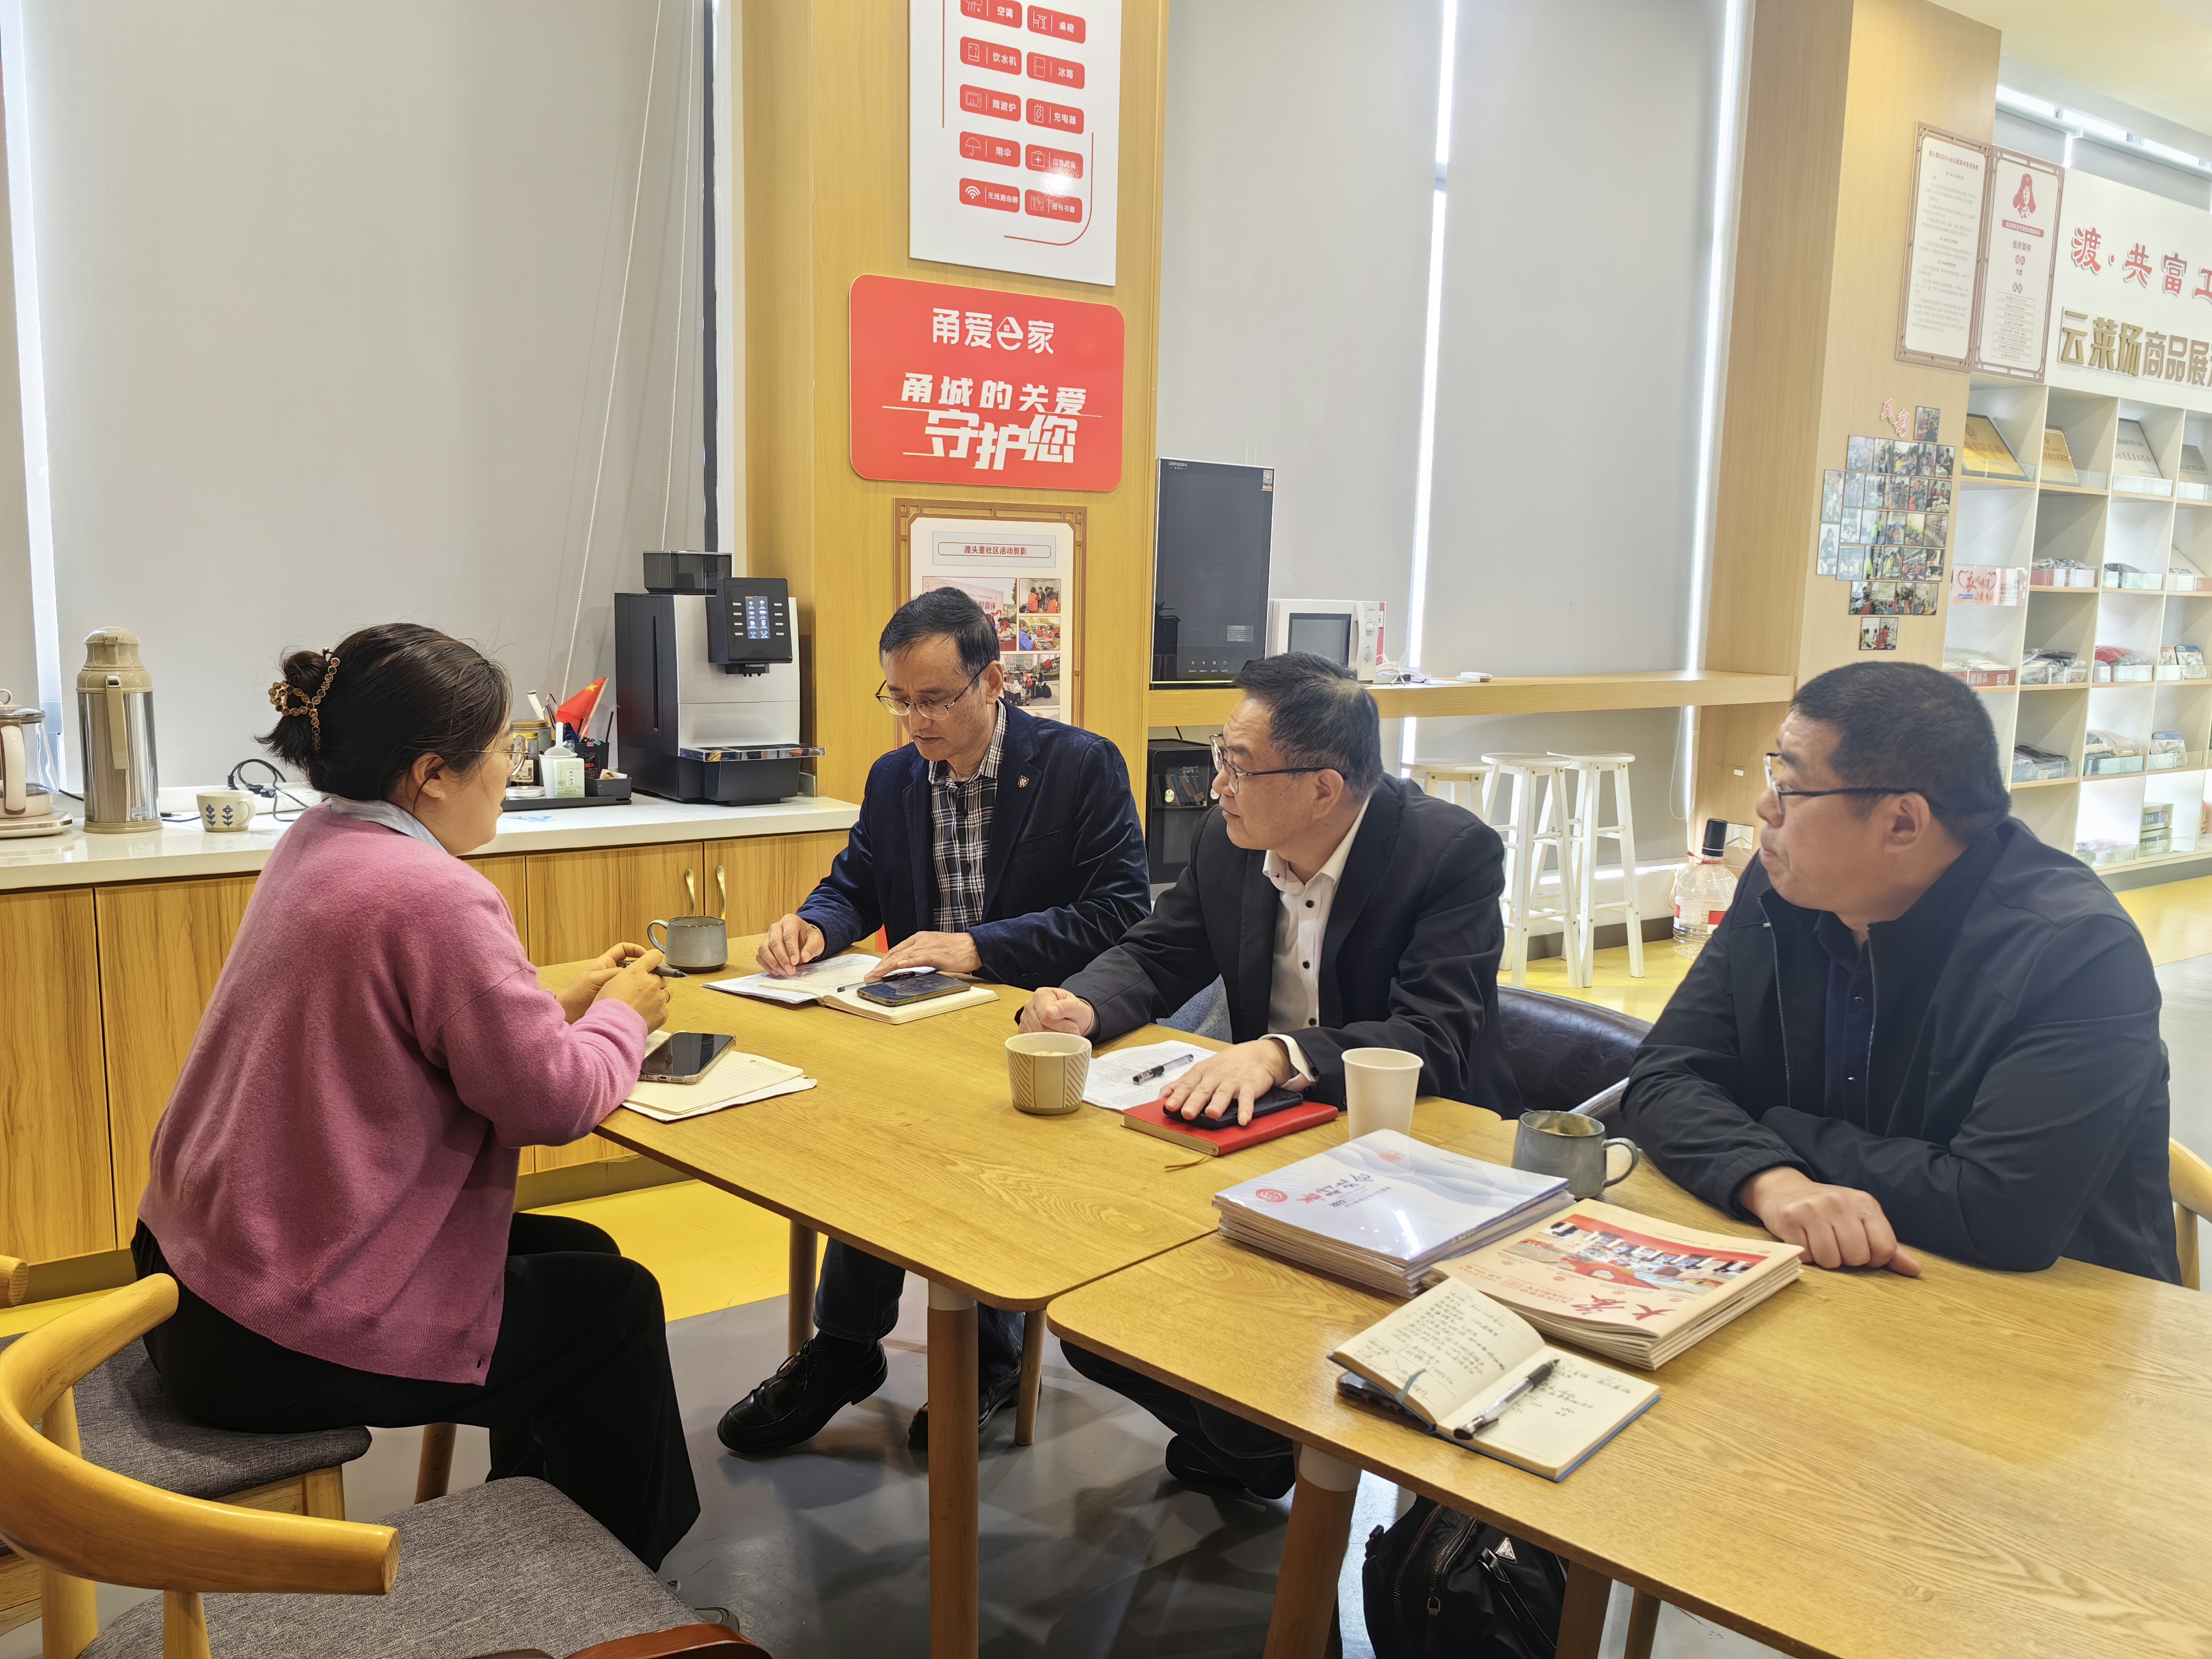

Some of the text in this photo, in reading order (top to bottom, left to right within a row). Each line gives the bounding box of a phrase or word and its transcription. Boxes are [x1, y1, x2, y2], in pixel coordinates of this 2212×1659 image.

[997, 6, 1013, 18] 空调
[1059, 21, 1074, 33] 桌椅
[993, 52, 1017, 66] 饮水机
[1058, 67, 1074, 79] 冰箱
[992, 99, 1016, 112] 微波炉
[1054, 112, 1076, 125] 充电器
[995, 146, 1011, 158] 雨伞
[988, 192, 1019, 204] 无线路由器
[2060, 309, 2212, 387] 云菜场商品展
[900, 373, 1087, 415] 甬城的关爱
[924, 408, 1078, 470] 守护您
[964, 545, 1027, 555] 渡头董社区活动剪影
